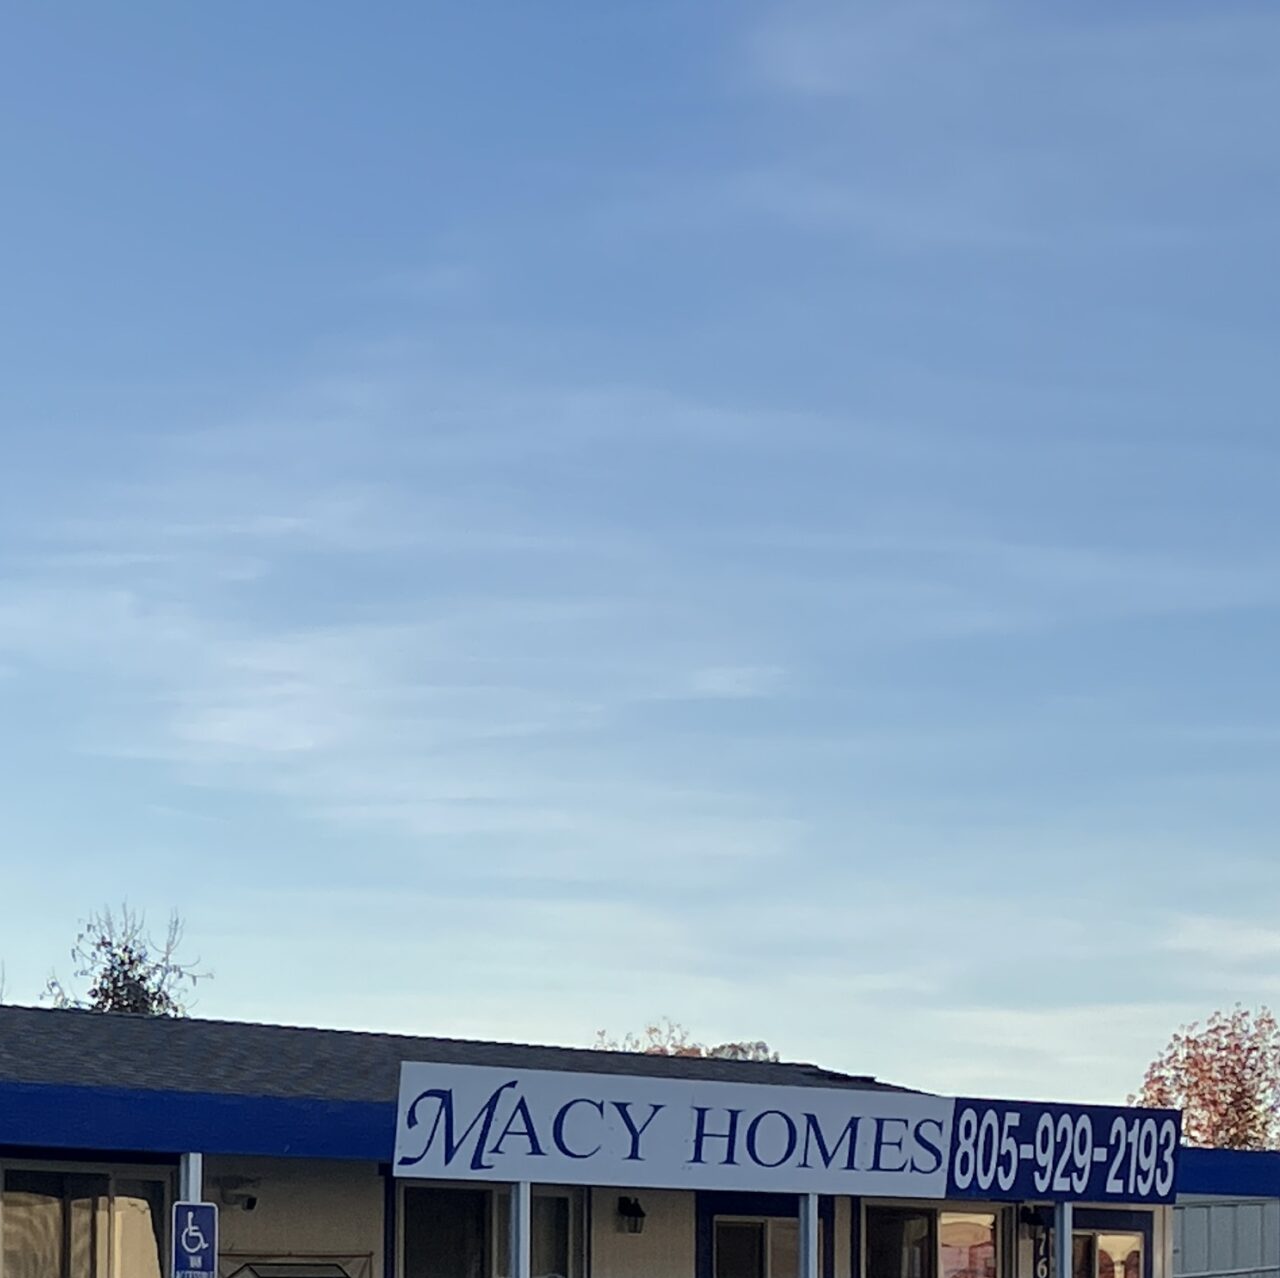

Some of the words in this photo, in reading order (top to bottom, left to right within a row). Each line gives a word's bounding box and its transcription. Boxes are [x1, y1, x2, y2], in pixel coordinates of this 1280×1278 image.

[397, 1080, 666, 1171] MACY
[686, 1107, 944, 1175] HOMES
[954, 1108, 1176, 1196] 805-929-2193
